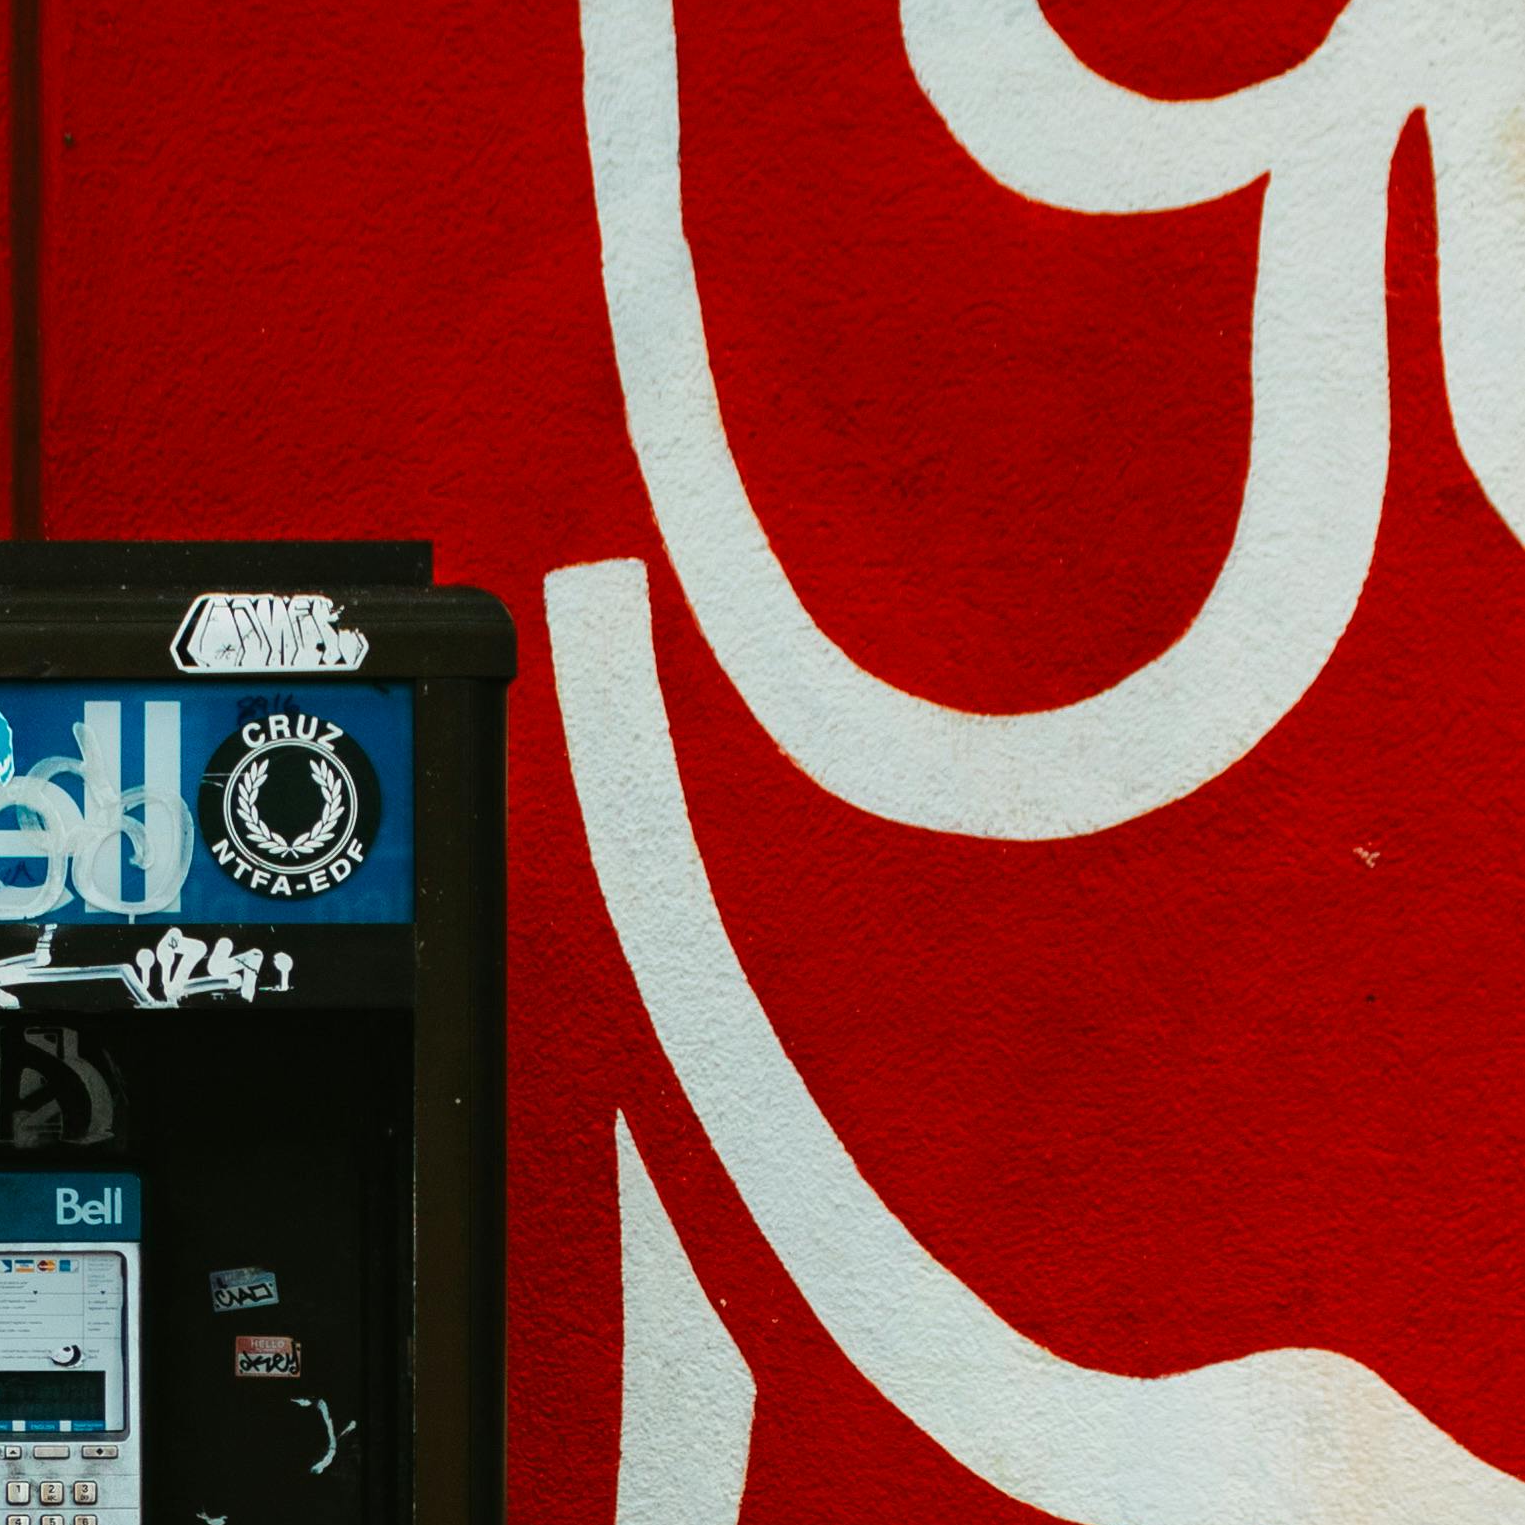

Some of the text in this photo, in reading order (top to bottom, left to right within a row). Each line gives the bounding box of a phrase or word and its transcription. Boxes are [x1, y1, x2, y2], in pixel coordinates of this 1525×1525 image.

[242, 714, 344, 752] CRUZ
[211, 838, 364, 896] NTFA-EDF
[55, 1187, 123, 1225] Bell
[250, 1339, 285, 1349] HELLO
[48, 1485, 55, 1493] 2
[81, 1485, 89, 1493] 3
